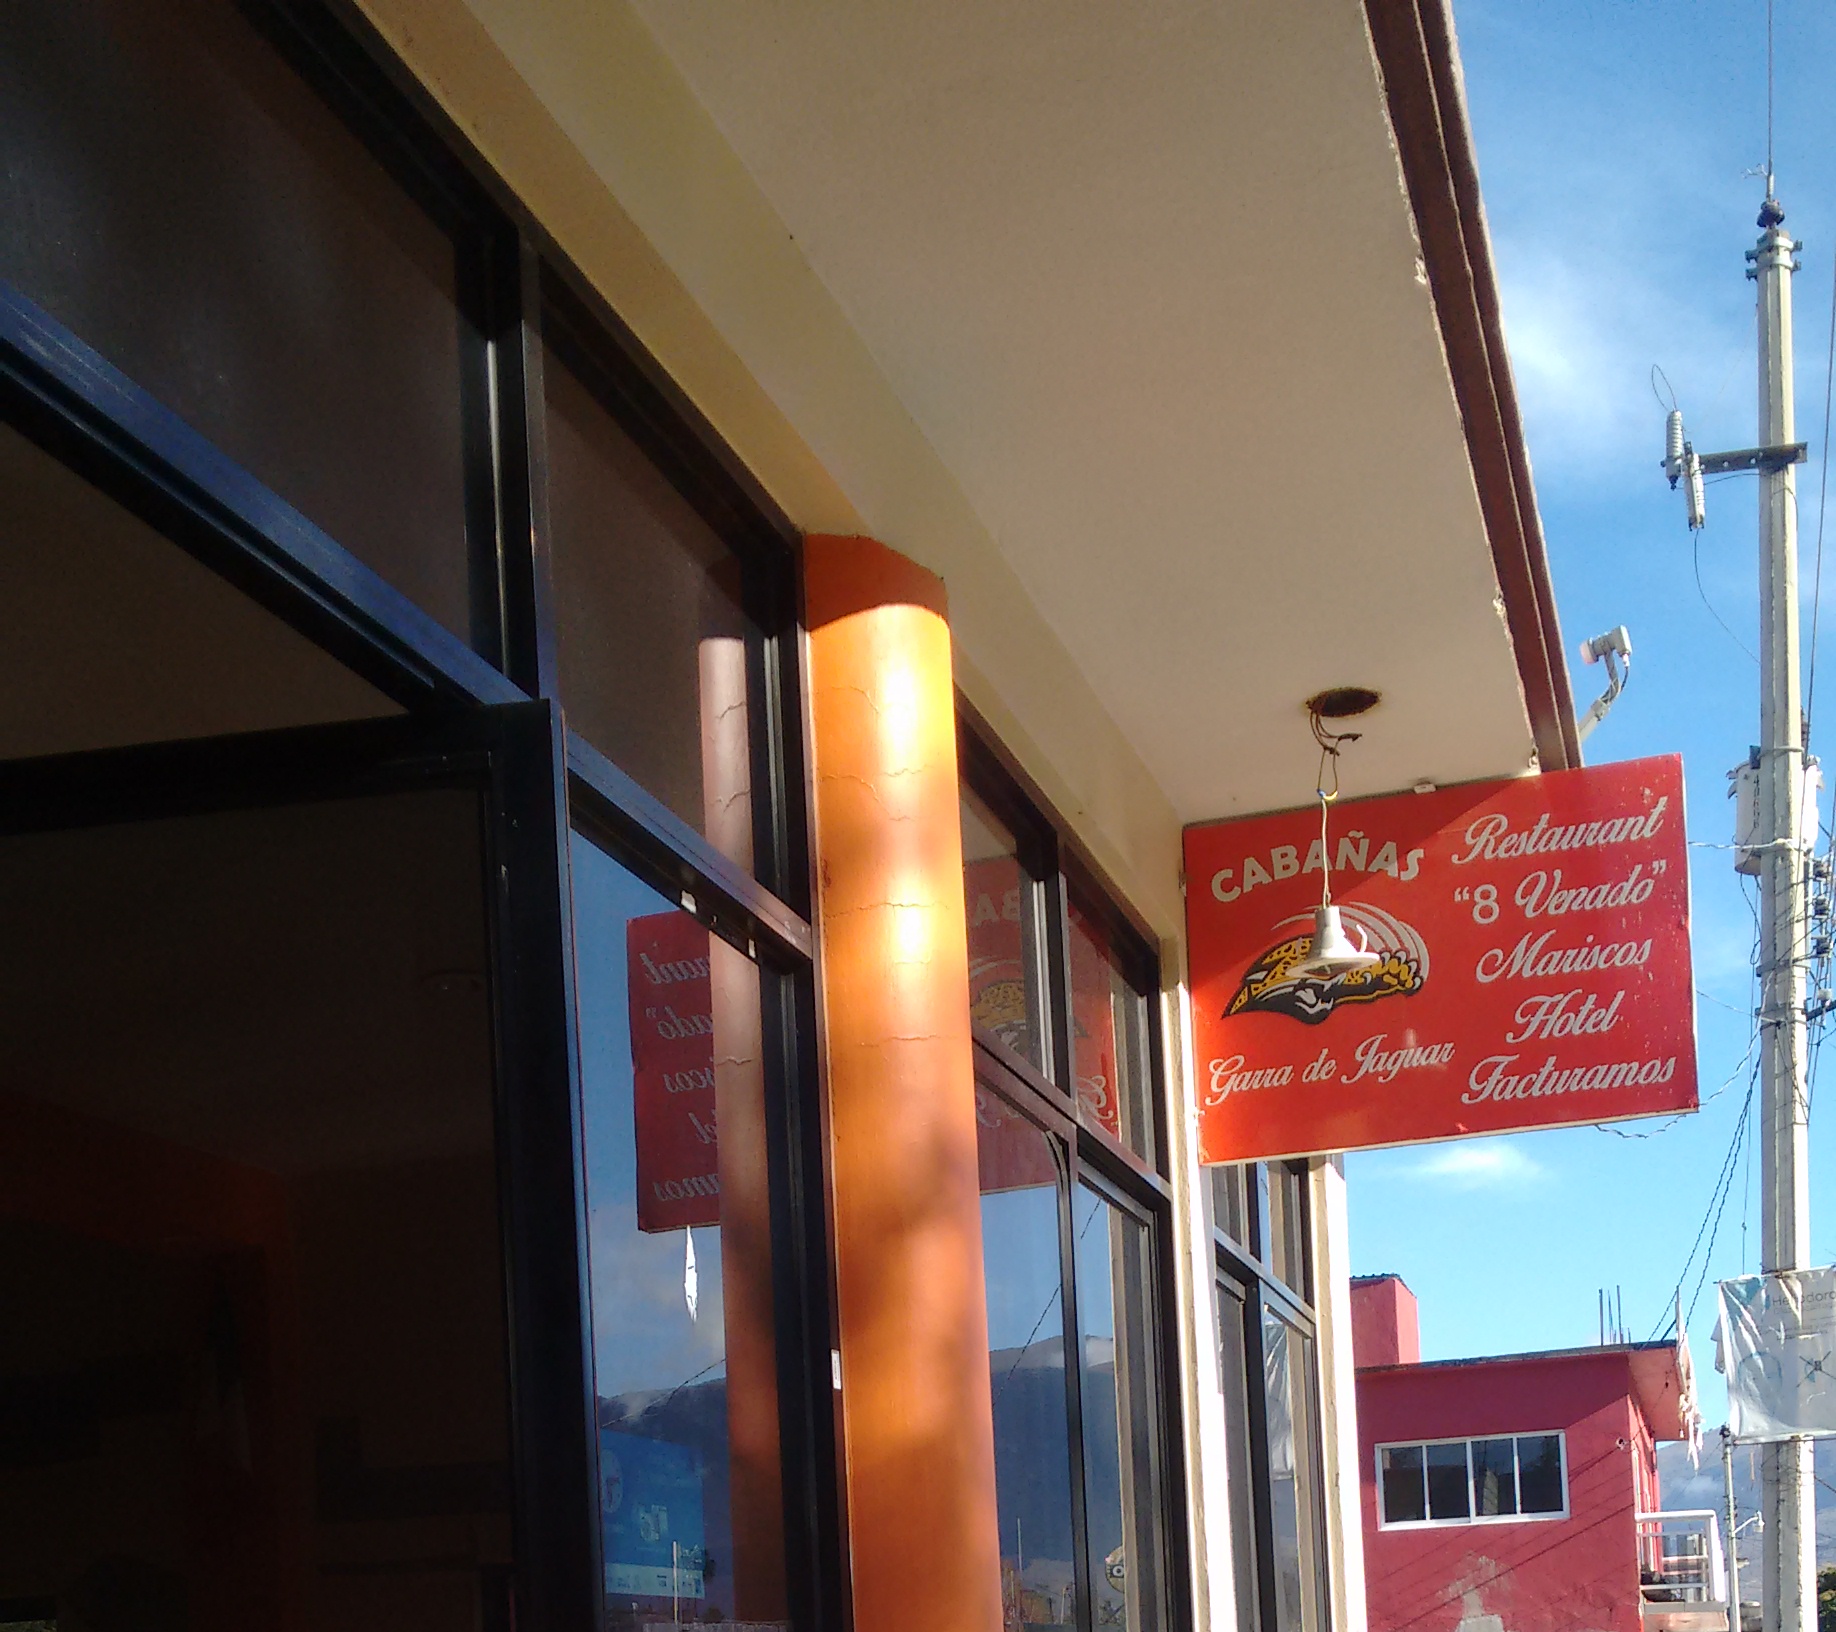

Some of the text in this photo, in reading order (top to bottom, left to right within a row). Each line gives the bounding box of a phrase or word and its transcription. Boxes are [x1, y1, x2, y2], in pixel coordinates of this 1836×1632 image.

[1452, 796, 1669, 865] Restaurant
[1211, 829, 1425, 903] CABAÑAS
[1476, 932, 1654, 983] Mariscos
[1505, 989, 1625, 1045] Hotel
[1205, 1034, 1456, 1106] Garra de Jaguar
[1461, 1055, 1676, 1104] Facturamos
